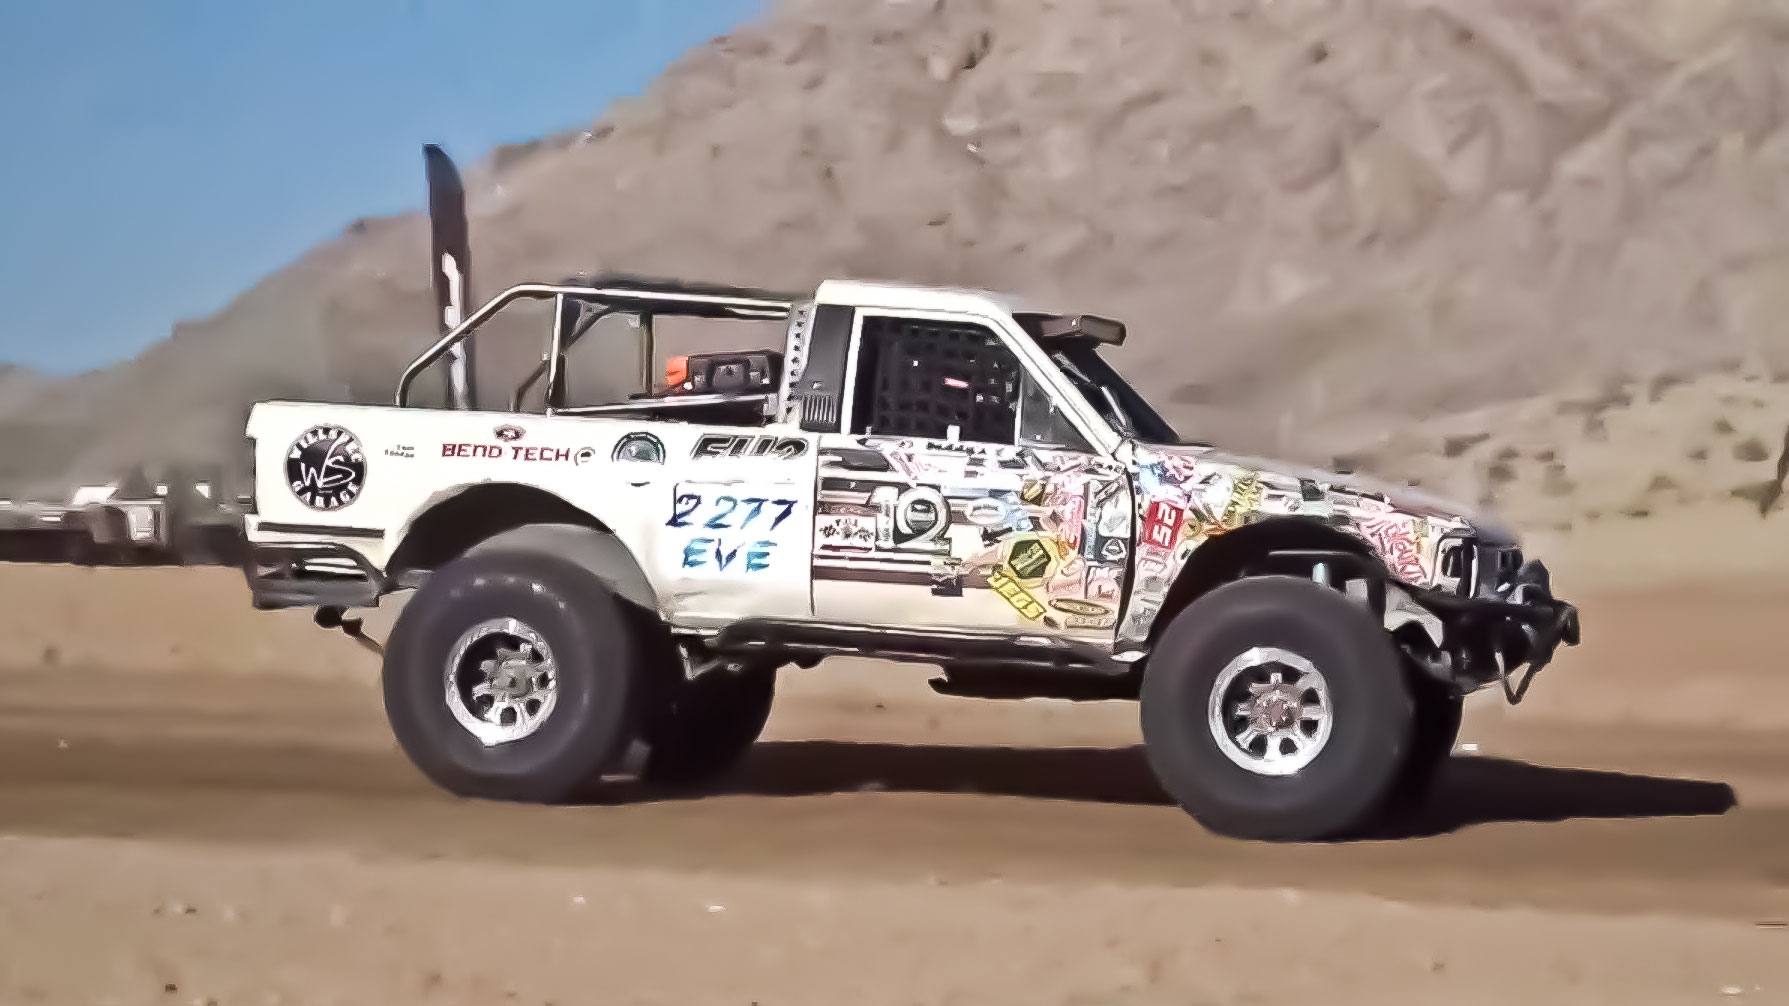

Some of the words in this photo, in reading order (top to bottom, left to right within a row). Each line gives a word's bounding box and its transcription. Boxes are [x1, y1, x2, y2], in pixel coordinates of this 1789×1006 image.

[442, 443, 503, 458] BEND
[511, 446, 570, 461] TECH
[682, 537, 777, 572] EVE
